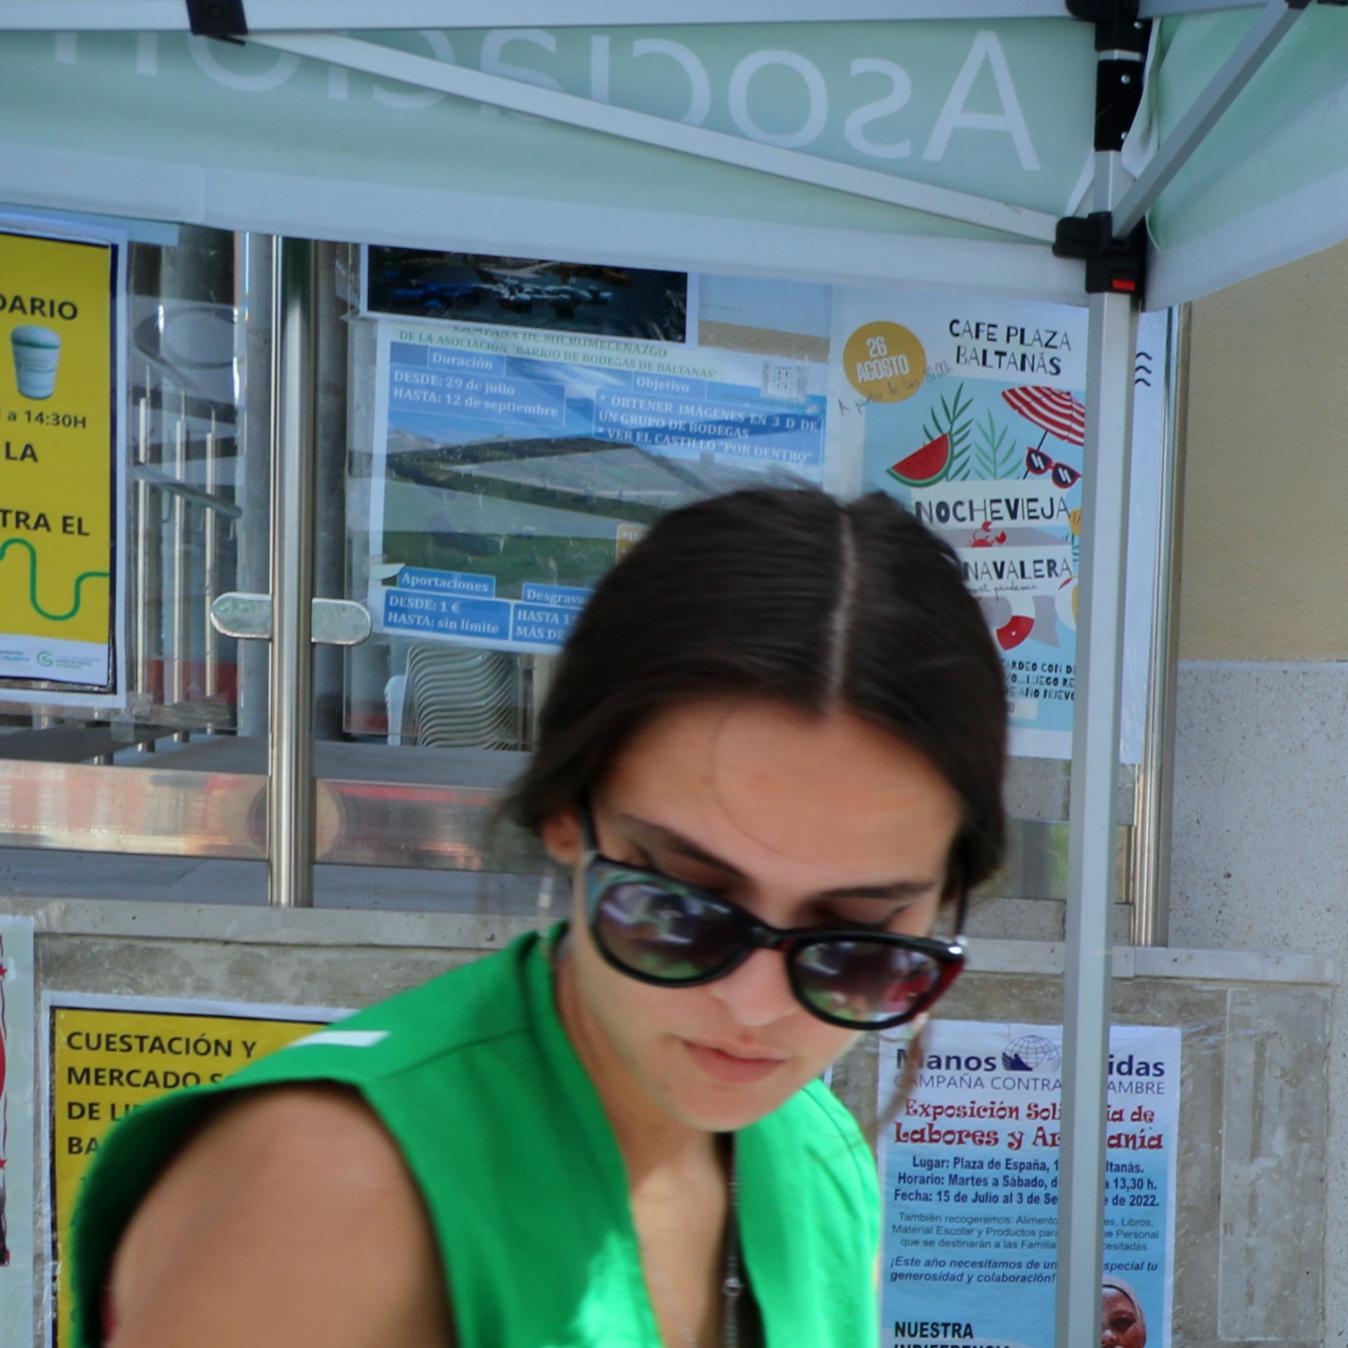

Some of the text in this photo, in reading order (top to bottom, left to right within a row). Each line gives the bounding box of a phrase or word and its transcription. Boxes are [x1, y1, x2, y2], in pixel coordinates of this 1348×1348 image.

[418, 331, 433, 344] LA
[949, 319, 1072, 351] CAFE PLAZA
[866, 335, 888, 359] 26
[432, 351, 493, 371] Duración
[856, 354, 909, 383] AGOSTO
[956, 345, 1062, 377] BALTANÁS
[394, 370, 516, 397] DESDE: 29 de julio
[636, 376, 690, 394] Objetivo
[394, 387, 559, 418] HASTA: 12 de septiembre
[7, 410, 88, 430] a 14:30H
[600, 410, 749, 440] UN GRUPO DE BODEGAS
[611, 396, 818, 433] OBTENER IMÁGENES EN 3 D DE
[607, 428, 633, 442] VER
[636, 431, 652, 444] EL
[654, 432, 717, 451] CASTILLO
[4, 441, 39, 463] LA
[915, 496, 1071, 524] NOCHEVIEJA
[61, 515, 90, 537] EL
[401, 572, 489, 593] Aportaciones
[389, 595, 461, 614] DESDE: 1 €
[388, 610, 499, 634] HASTA: sin límite
[517, 608, 559, 625] HASTA
[517, 624, 545, 640] MÁS
[66, 1031, 257, 1059] CUESTACIÓN Y
[1107, 1053, 1165, 1077] idas
[67, 1066, 200, 1090] MERCADO
[990, 1075, 1062, 1091] CONTRA
[1108, 1081, 1165, 1095] AMBRE
[67, 1101, 101, 1121] DE
[905, 1099, 1155, 1123] Exposición de
[894, 1121, 1025, 1150] Labores y
[912, 1155, 951, 1171] Lugar:
[953, 1156, 984, 1170] Plaza
[987, 1158, 1001, 1170] de
[1005, 1158, 1050, 1174] España,
[898, 1172, 1157, 1192] Horario: Martes a Sábado, 13,30 h.
[894, 1188, 933, 1203] Fecha:
[936, 1189, 950, 1202] 15
[953, 1190, 968, 1203] de
[971, 1190, 999, 1204] Julio
[1002, 1191, 1013, 1204] al
[1016, 1192, 1024, 1204] 3
[1026, 1191, 1040, 1205] de
[1111, 1194, 1126, 1206] de
[1129, 1194, 1160, 1207] 2022.
[898, 1211, 942, 1223] También
[944, 1216, 1011, 1226] recogeremos:
[1015, 1216, 1058, 1225] Alimento
[892, 1224, 934, 1236] Material
[936, 1225, 975, 1236] Escolar
[975, 1228, 983, 1238] y
[985, 1227, 1036, 1237] Productos
[1116, 1229, 1160, 1240] Personal
[900, 1240, 920, 1249] que
[922, 1240, 935, 1248] se
[937, 1238, 992, 1249] destinarán
[994, 1241, 1000, 1249] a
[1003, 1239, 1018, 1249] las
[923, 1257, 946, 1269] año
[950, 1257, 1023, 1270] necesitamos
[1025, 1258, 1040, 1270] de
[1104, 1261, 1145, 1273] special
[1146, 1262, 1159, 1272] tu
[889, 1271, 1057, 1285] generosidad y colaboración!
[894, 1321, 974, 1339] NUESTRA
